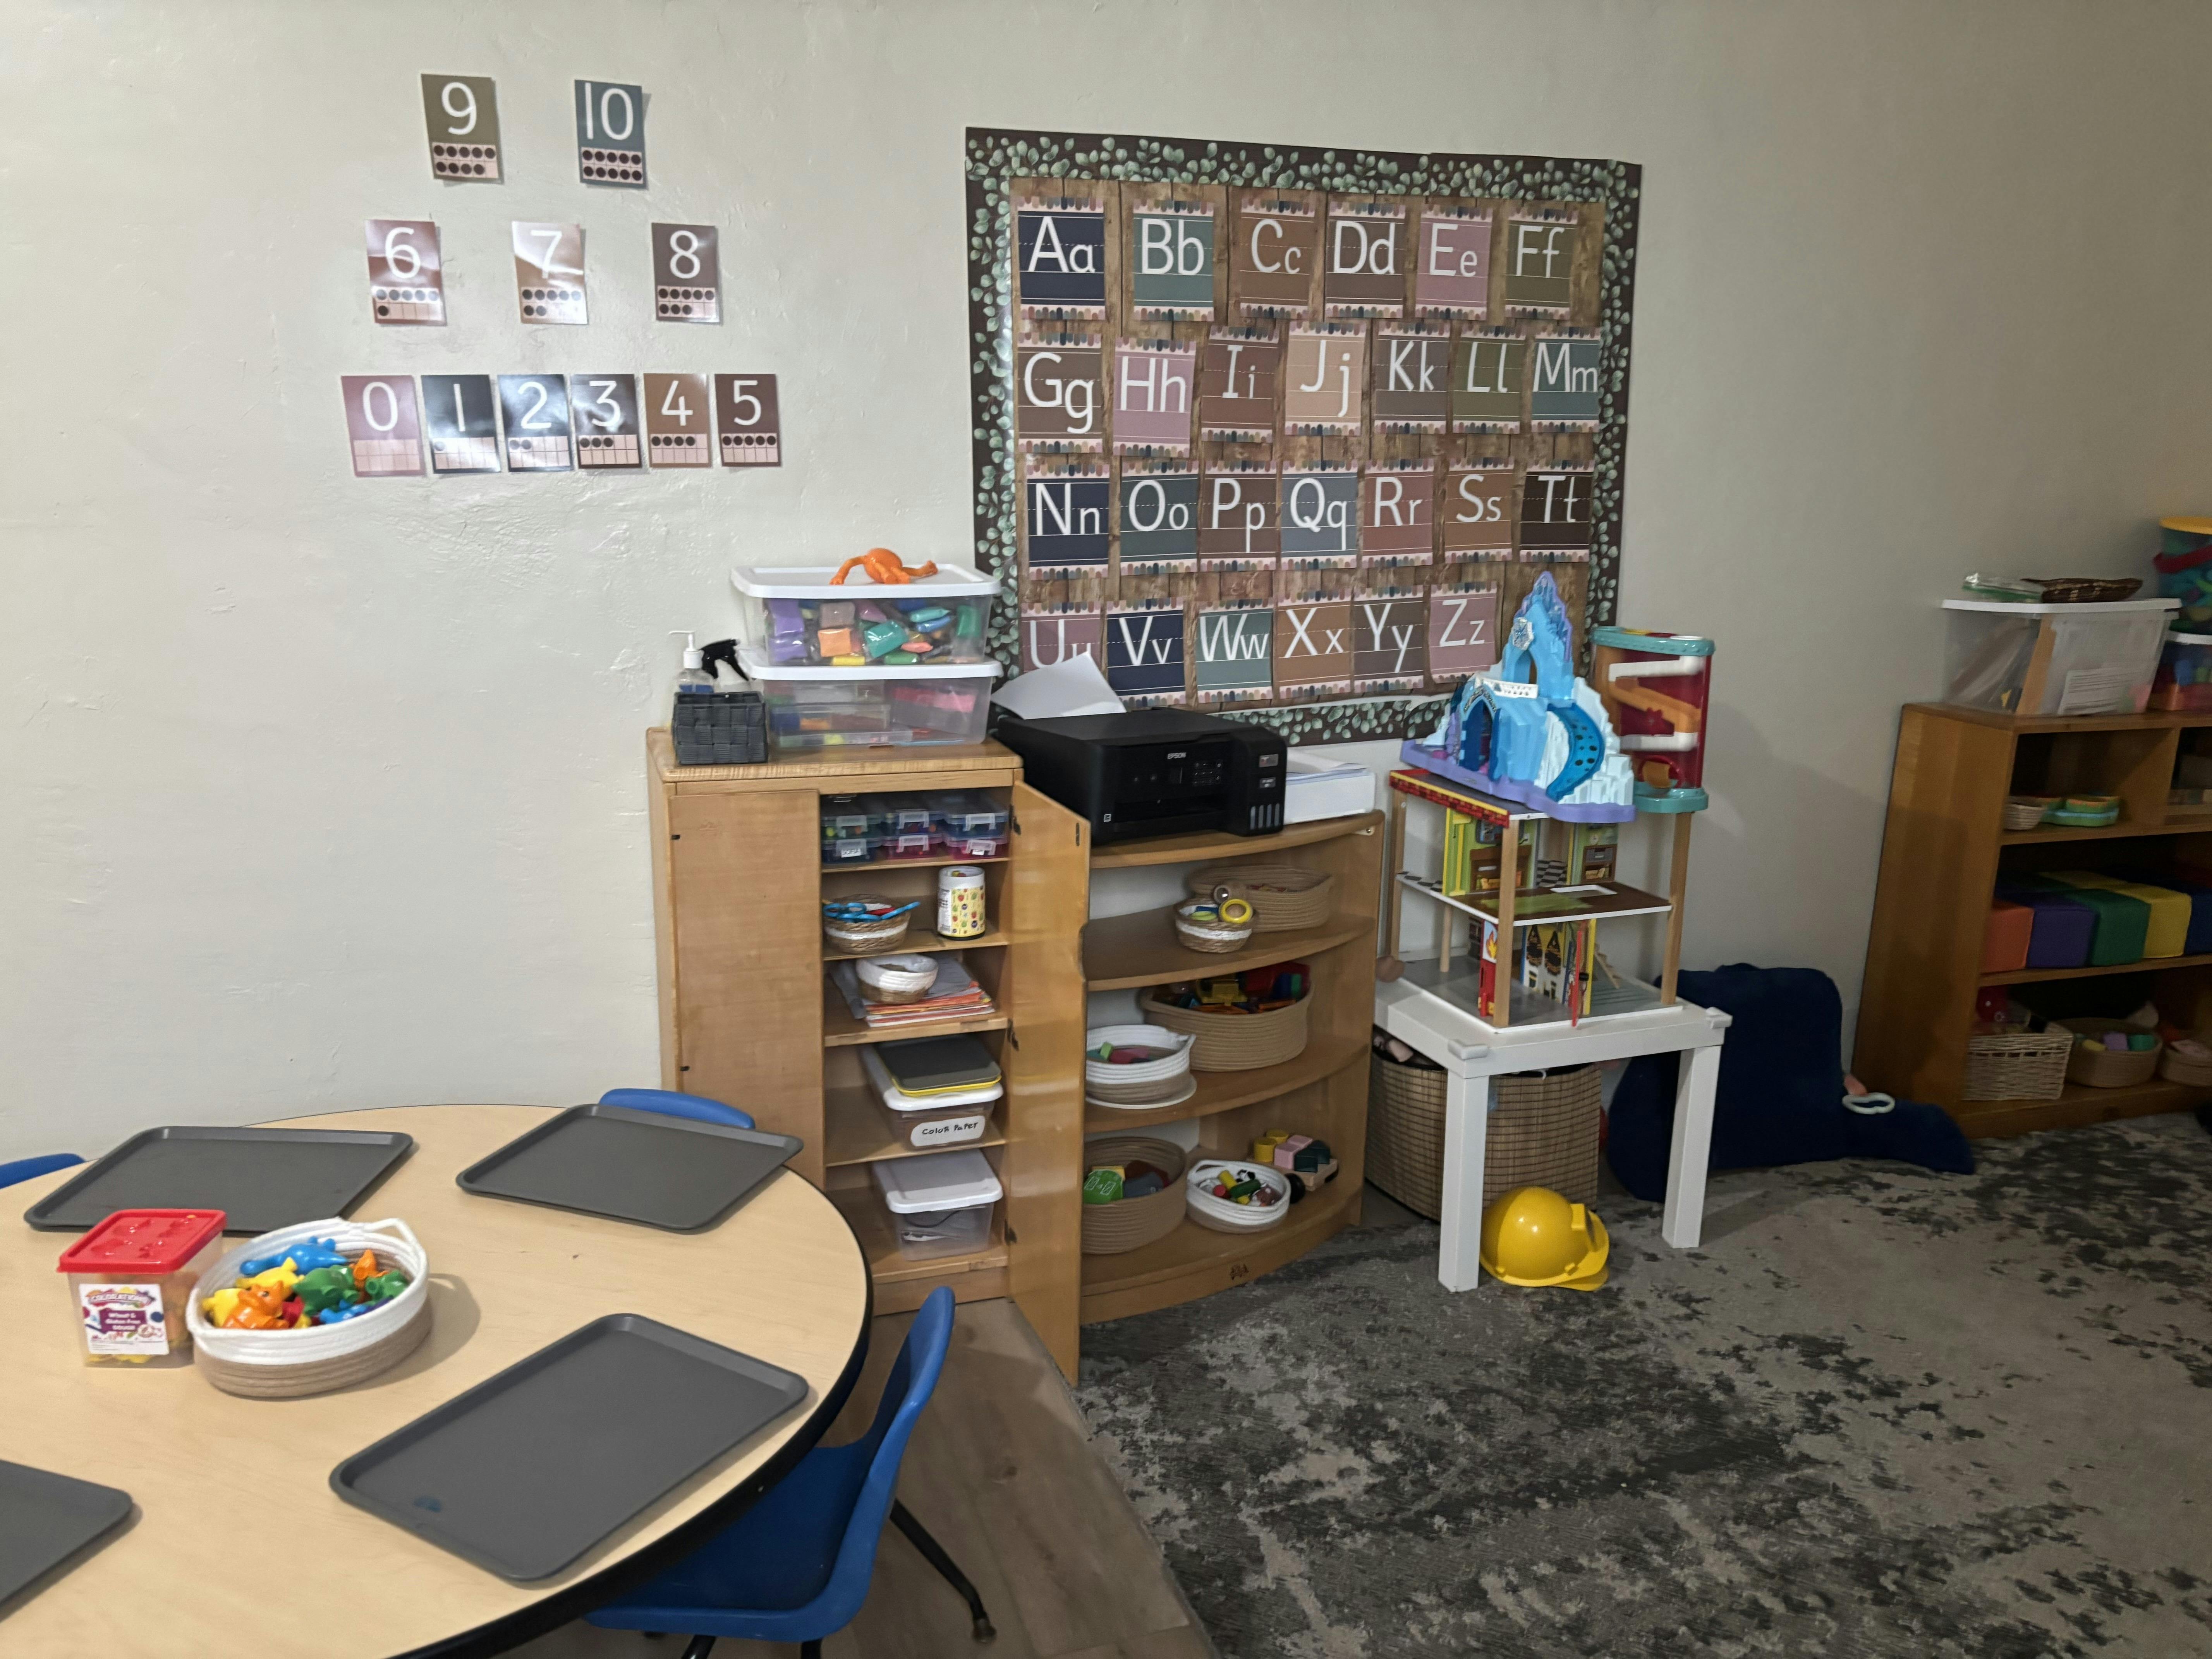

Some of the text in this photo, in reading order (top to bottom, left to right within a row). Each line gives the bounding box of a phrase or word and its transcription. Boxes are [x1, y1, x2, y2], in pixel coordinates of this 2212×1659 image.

[441, 82, 477, 135] 9
[584, 83, 633, 140] 10
[385, 227, 421, 279] 6
[531, 229, 563, 279] 7
[669, 230, 700, 279] 8
[1028, 216, 1096, 273] Aa
[1141, 218, 1204, 275] Bb
[1251, 219, 1301, 273] Cc
[1333, 220, 1395, 275] Dd
[1429, 223, 1478, 276] Ee
[1516, 225, 1565, 278] Ff
[1120, 356, 1186, 412] Hh
[1223, 345, 1256, 398] Ii
[1300, 340, 1350, 417] Jj
[1389, 340, 1434, 392] Kk
[1467, 342, 1508, 393] Ll
[1533, 342, 1598, 392] Mm
[362, 381, 398, 431] 0
[517, 381, 551, 429] 2
[589, 380, 621, 427] 3
[661, 380, 693, 426] 4
[733, 380, 762, 425] 5
[1024, 352, 1093, 434] Gg
[1036, 483, 1100, 536] Nn
[1128, 480, 1188, 531] Oo
[1212, 478, 1266, 553] Pp
[1290, 477, 1346, 550] Qq
[1374, 477, 1422, 527] Rr
[1456, 474, 1501, 524] Ss
[1538, 475, 1578, 524] Tt
[1119, 616, 1172, 666] Vv
[1200, 613, 1269, 661] Ww
[1285, 608, 1344, 658] Xx
[1364, 603, 1413, 673] Yy
[1439, 599, 1485, 647] Zz
